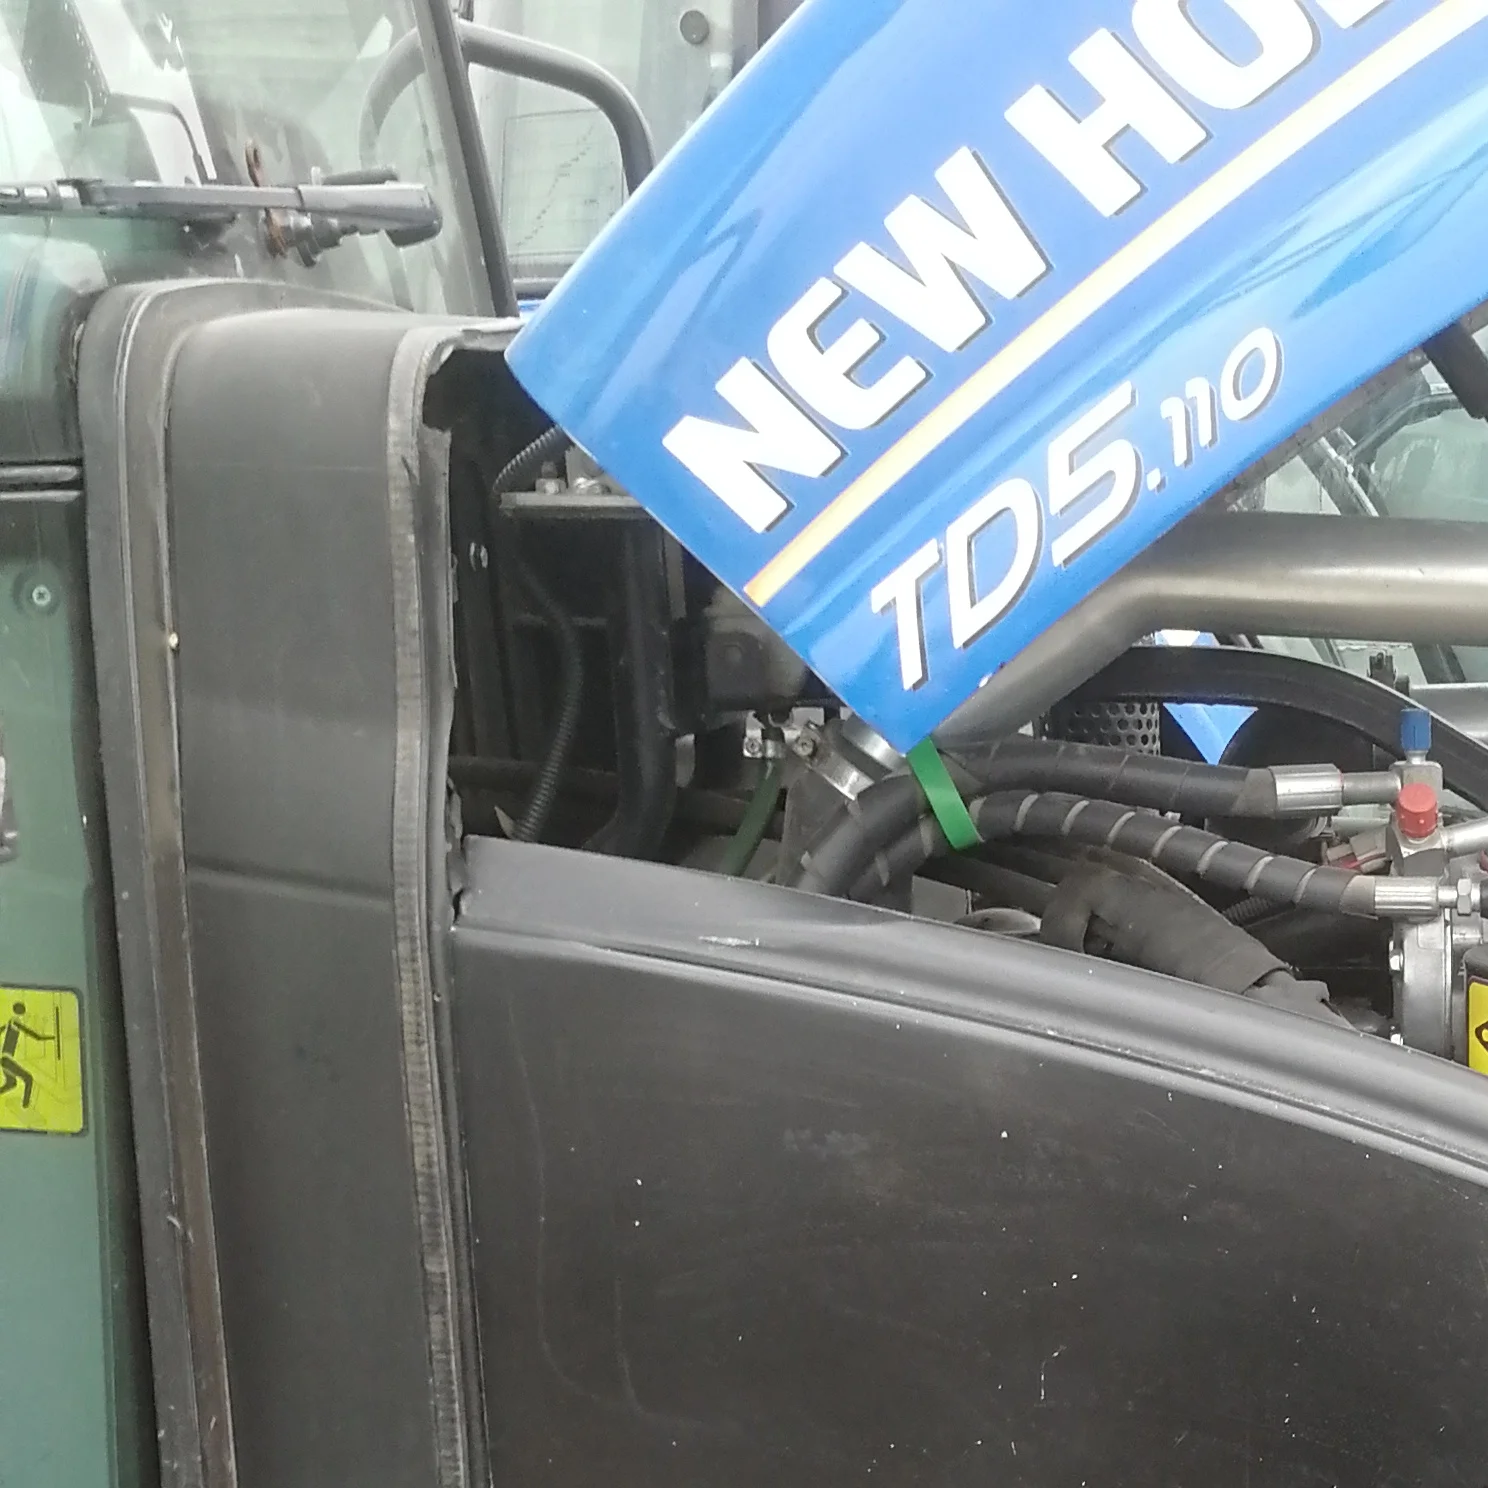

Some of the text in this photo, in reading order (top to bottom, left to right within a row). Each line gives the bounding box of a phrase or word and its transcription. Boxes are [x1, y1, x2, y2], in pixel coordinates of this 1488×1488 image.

[662, 0, 1392, 534] NEW HO
[870, 327, 1284, 691] TD5.110
